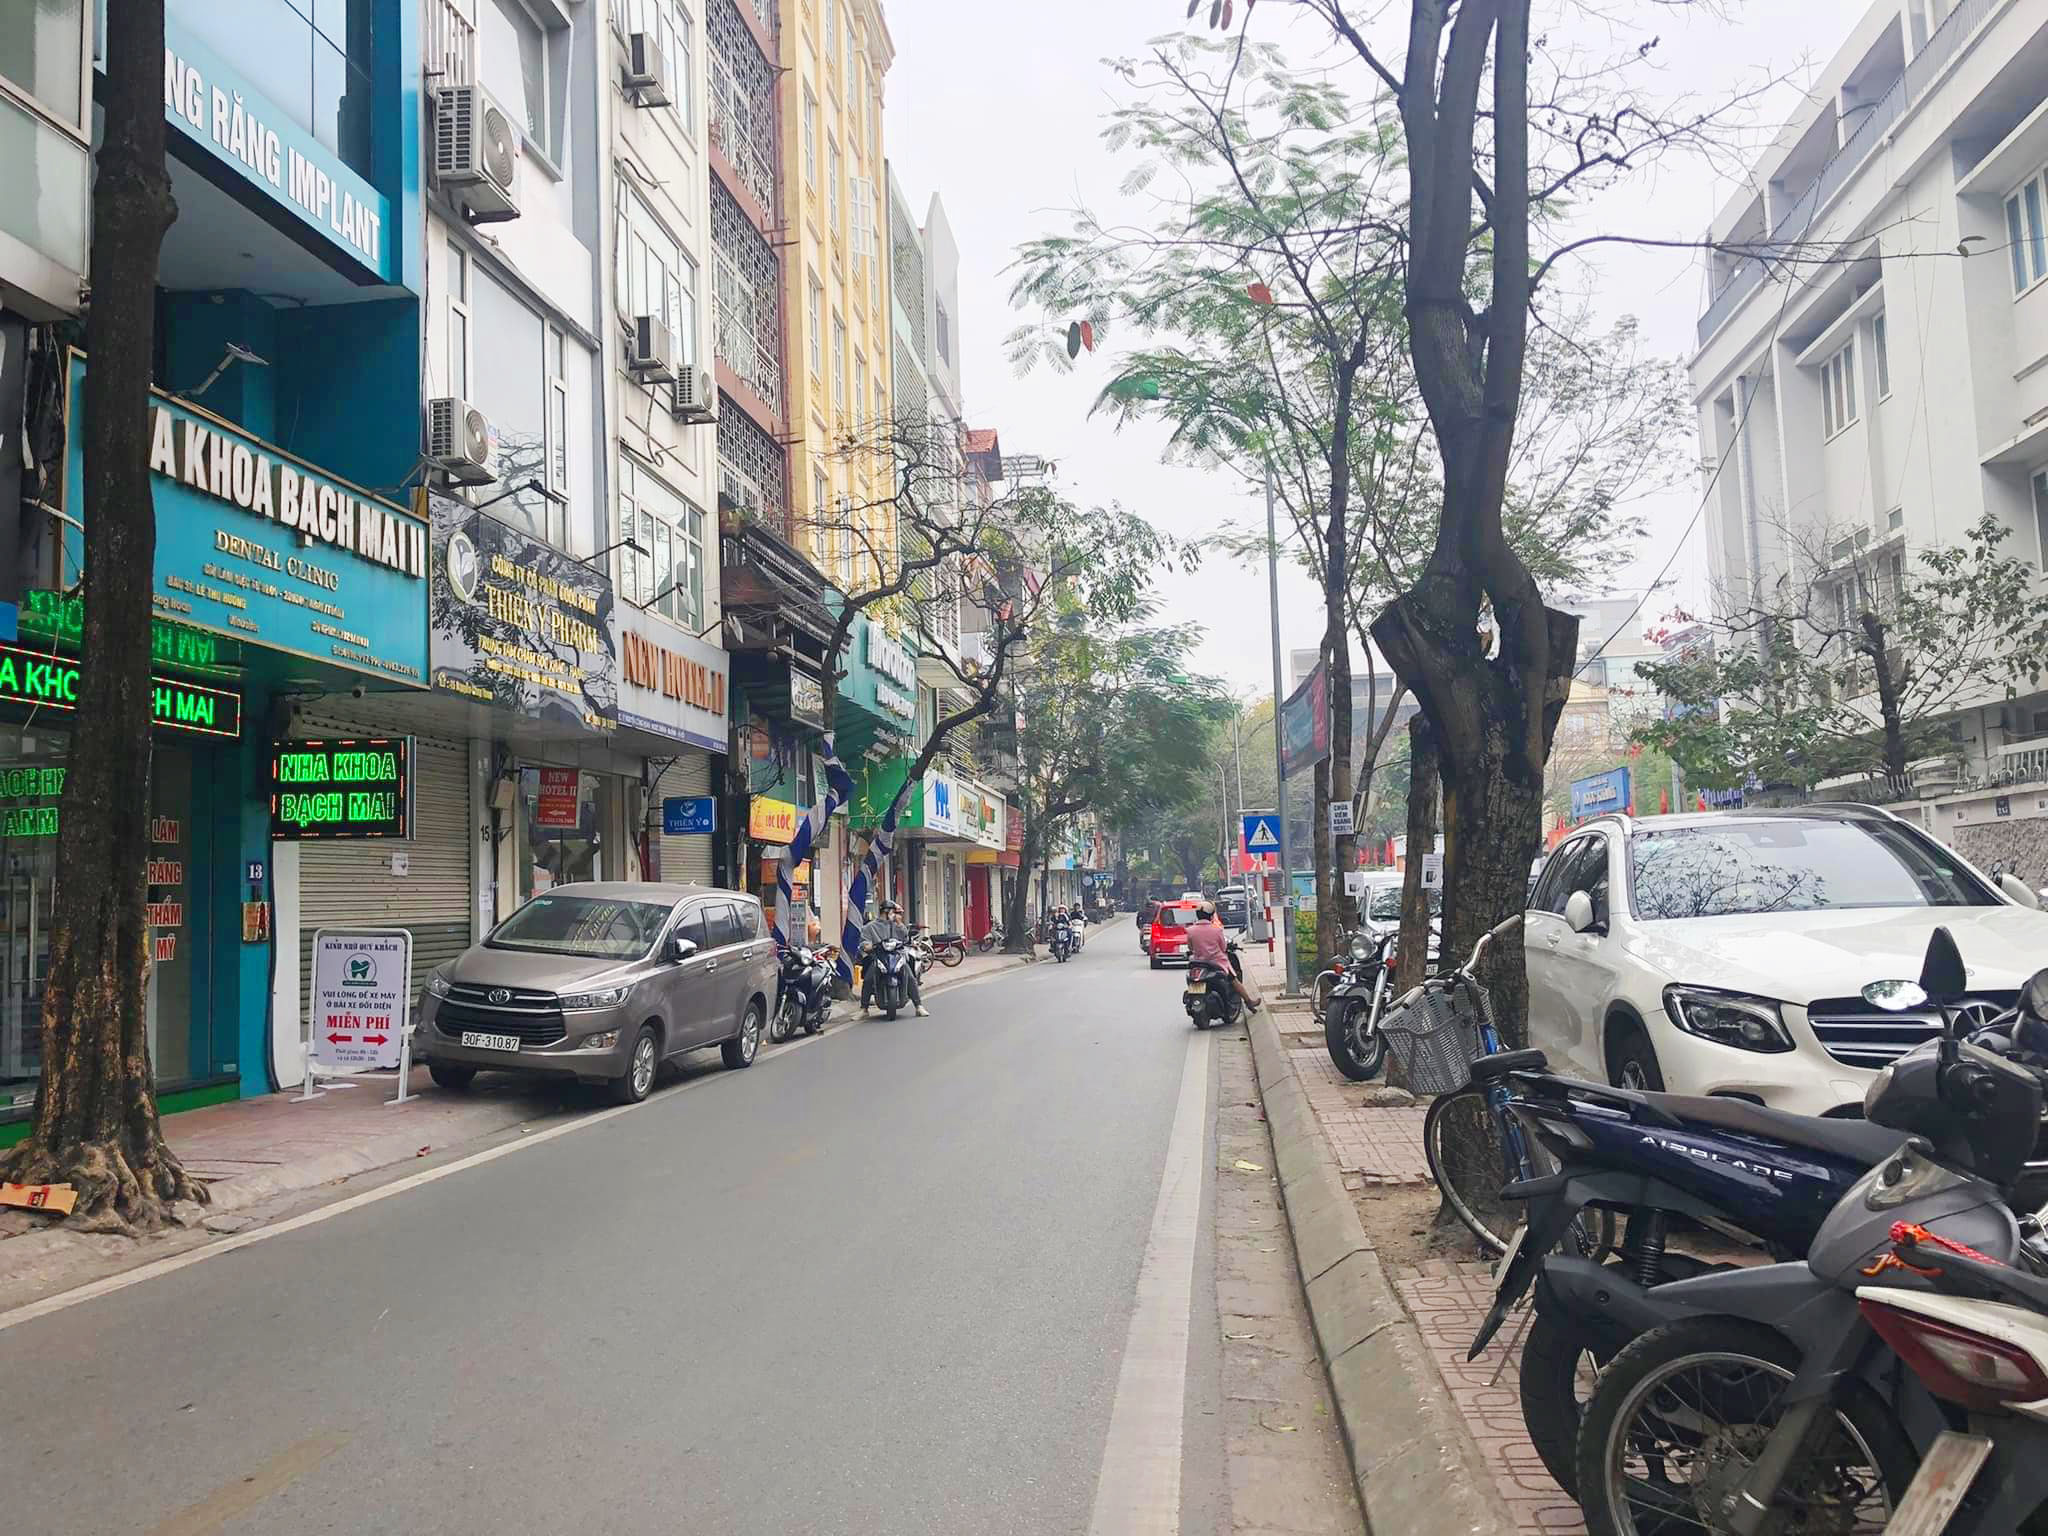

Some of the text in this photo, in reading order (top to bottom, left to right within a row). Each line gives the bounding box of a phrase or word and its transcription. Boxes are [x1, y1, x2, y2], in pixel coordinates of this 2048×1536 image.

[211, 86, 281, 189] RĂNG
[287, 146, 380, 263] IMPLANT
[184, 419, 274, 518] KHOA
[280, 463, 354, 551] BẠCH
[359, 502, 407, 573] MAI
[215, 529, 339, 591] DENTAL CLINIC
[550, 610, 598, 655] PHARM
[176, 691, 214, 725] MAI
[280, 752, 396, 782] NHA KHOA
[281, 792, 394, 828] BẠCH MAI
[480, 825, 490, 842] 15
[147, 857, 182, 885] RĂNG
[249, 864, 263, 879] 13
[146, 895, 182, 927] THẨM
[322, 990, 335, 998] VUI
[370, 991, 379, 999] XE
[327, 1011, 390, 1029] MIỄN PHÍ
[463, 1033, 518, 1049] 30F-310.87
